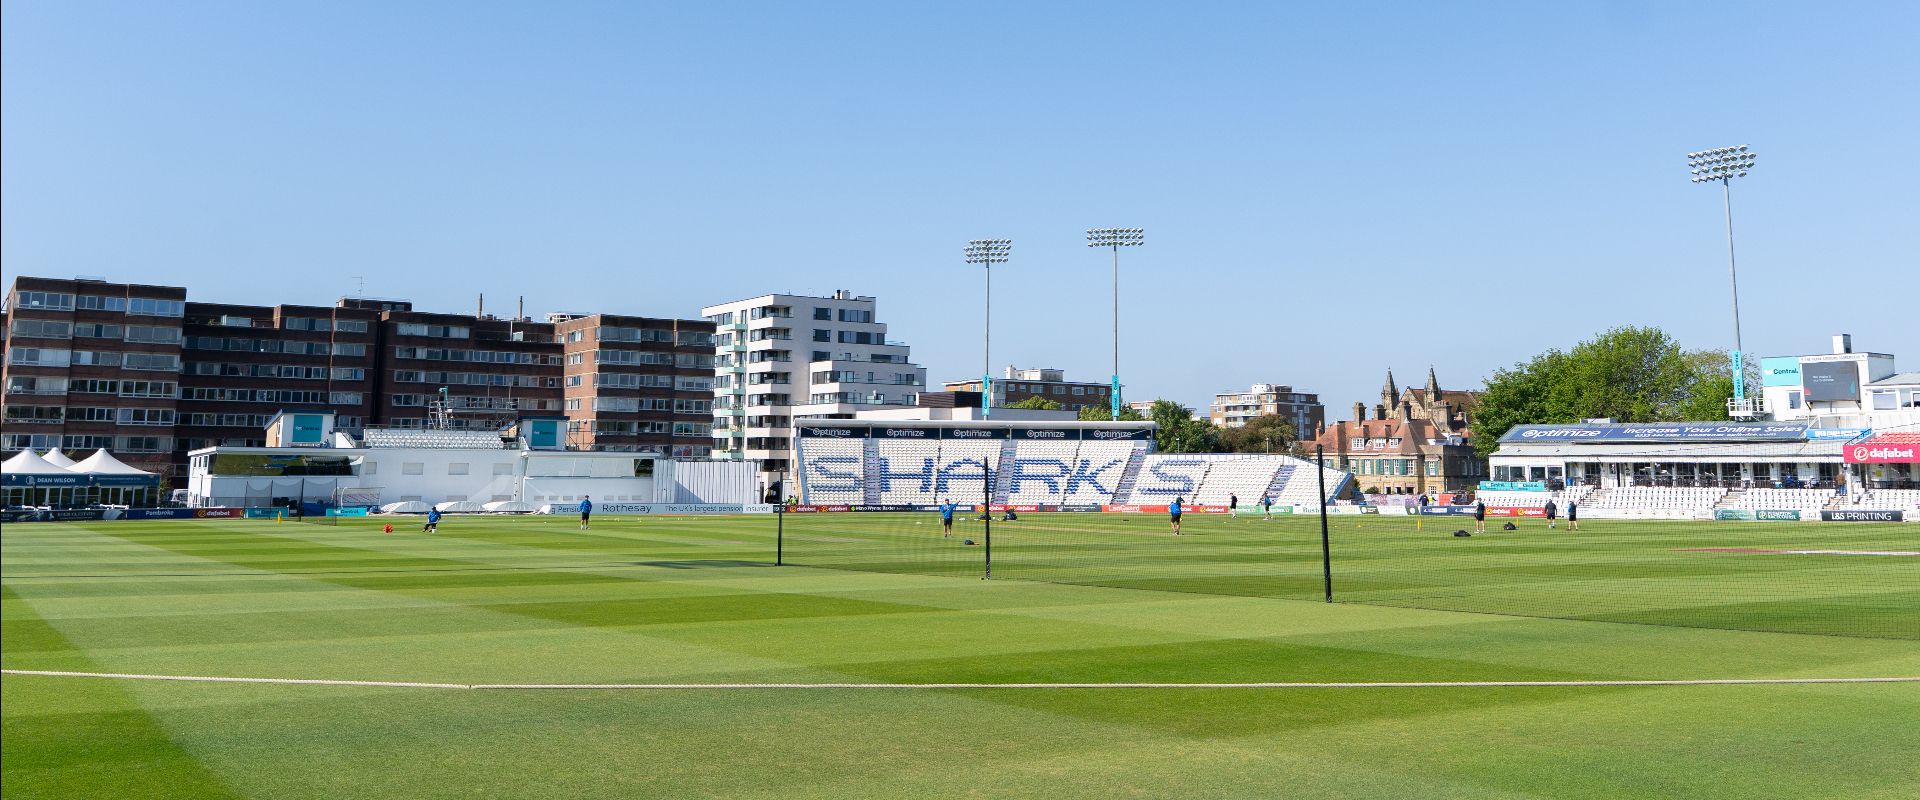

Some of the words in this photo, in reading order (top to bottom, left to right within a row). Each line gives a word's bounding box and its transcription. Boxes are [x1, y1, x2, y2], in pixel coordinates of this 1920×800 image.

[812, 427, 851, 437] Optimize
[886, 428, 925, 437] Optimize
[953, 429, 992, 438] Optimize
[1027, 429, 1065, 438] Optimize
[1094, 429, 1133, 439] Optimize
[1522, 428, 1602, 438] Optimize
[1683, 426, 1714, 434] Your
[1869, 447, 1914, 459] dafabet
[207, 508, 230, 516] dafabet
[602, 504, 652, 513] Rothesay
[694, 505, 717, 513] largest
[718, 505, 743, 513] pension
[1831, 512, 1845, 520] L&S
[1846, 512, 1892, 521] PRINTING
